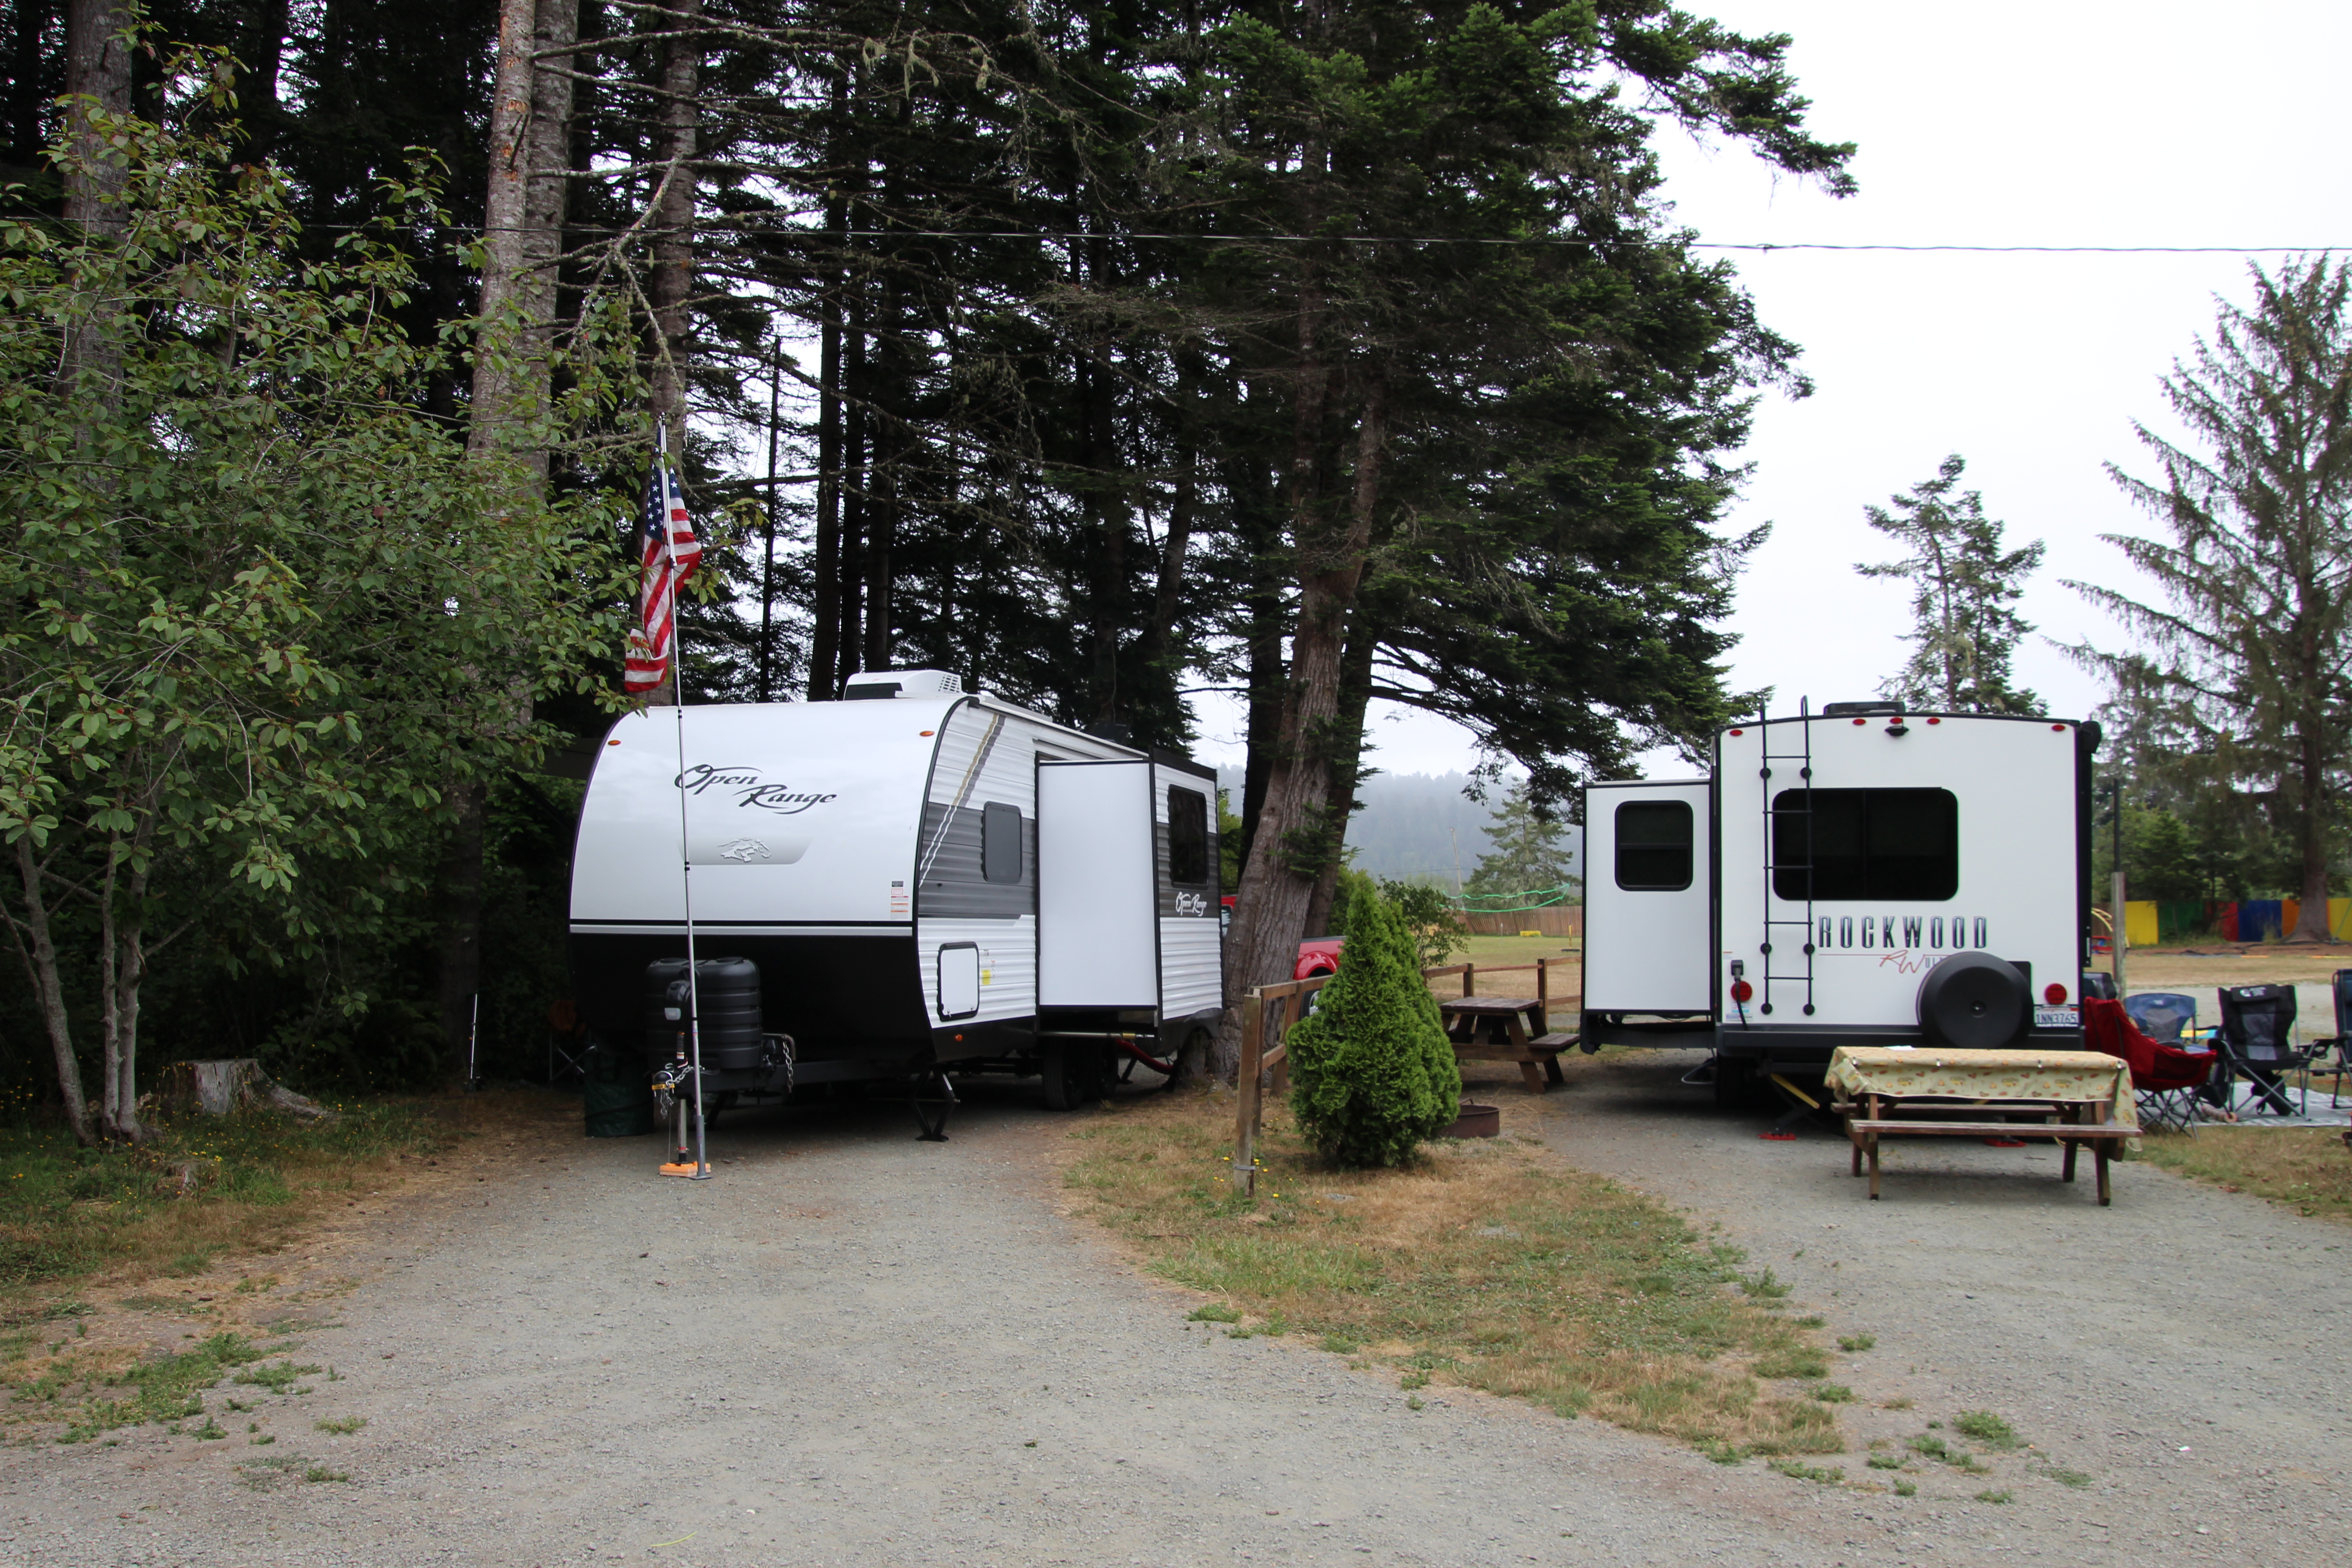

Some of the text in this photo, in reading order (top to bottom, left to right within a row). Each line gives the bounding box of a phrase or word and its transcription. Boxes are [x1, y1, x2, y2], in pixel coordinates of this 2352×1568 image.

[675, 764, 764, 795] Open
[732, 784, 837, 814] Range
[1818, 916, 1987, 948] ROCKWOOD
[2036, 1013, 2077, 1023] 1NN3765
